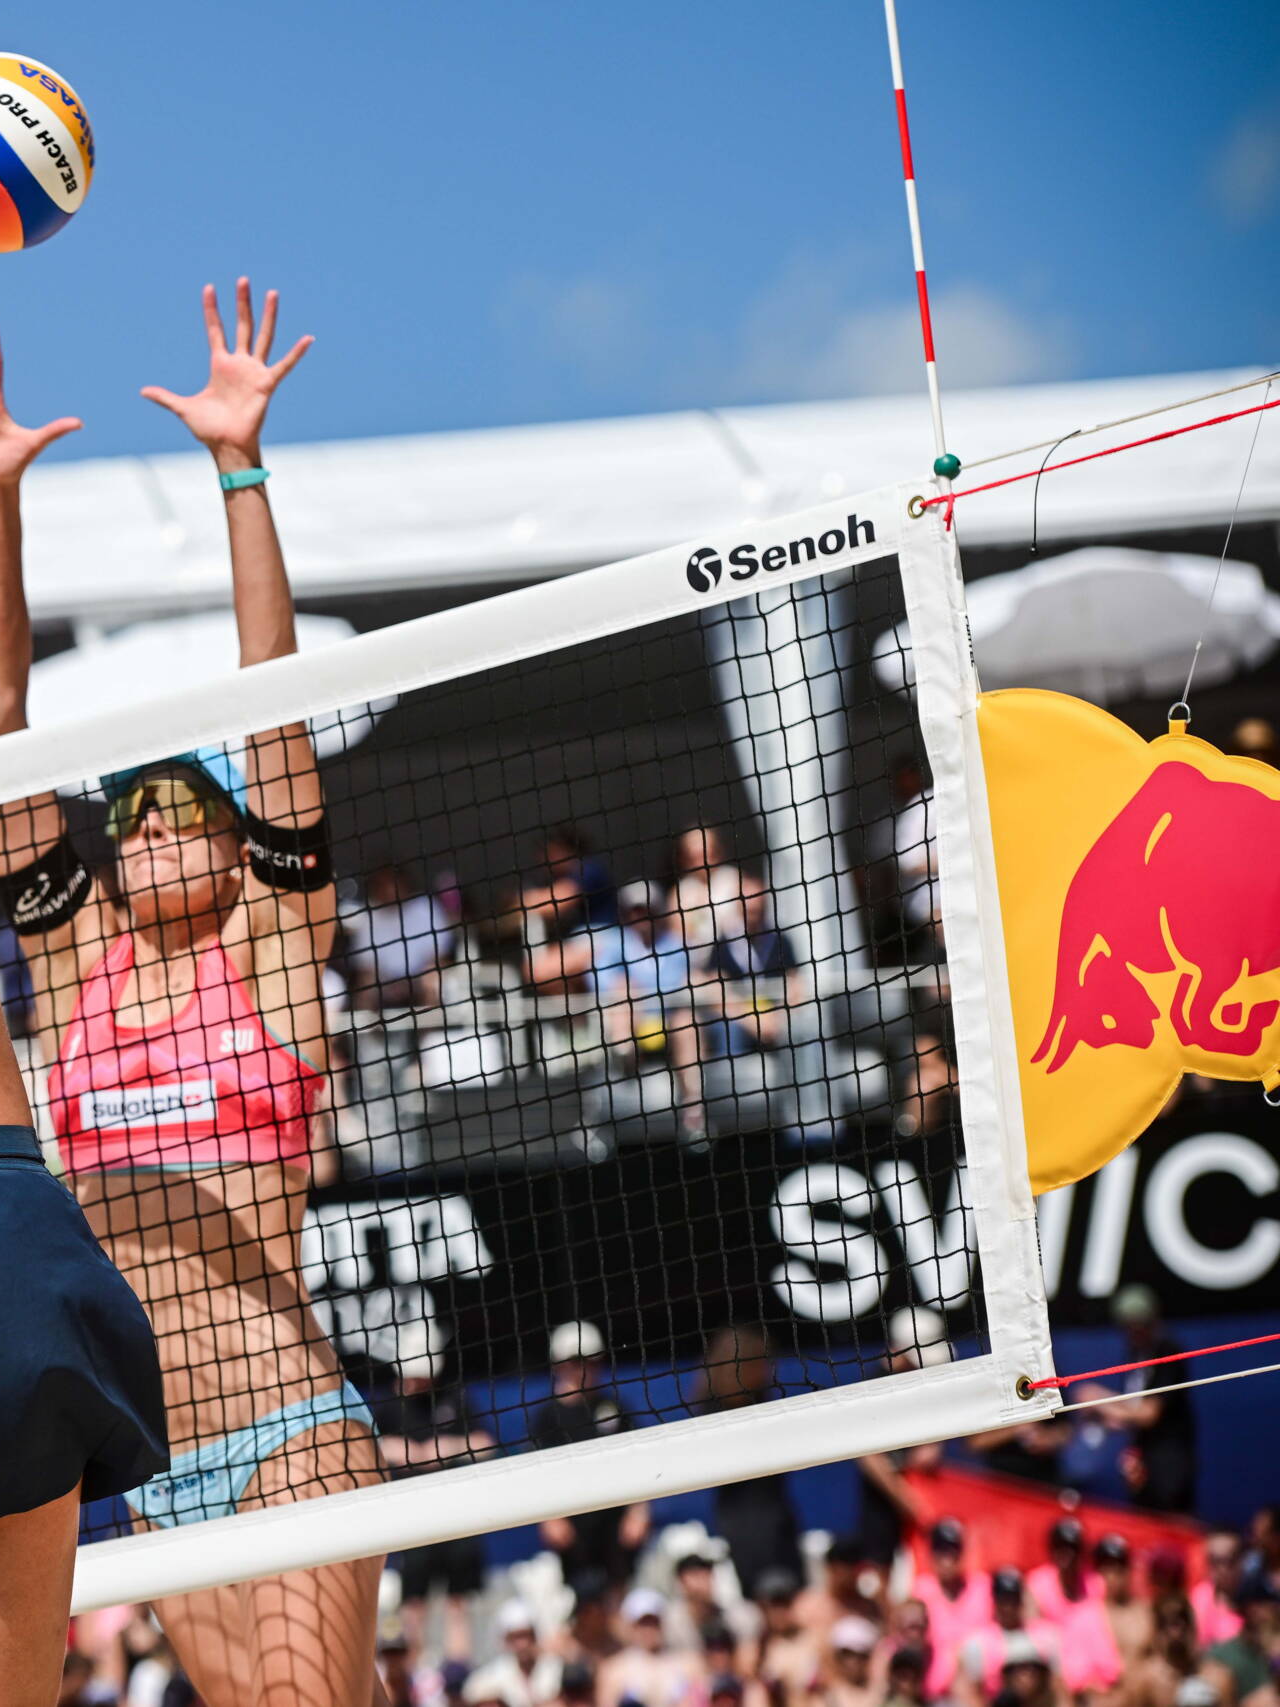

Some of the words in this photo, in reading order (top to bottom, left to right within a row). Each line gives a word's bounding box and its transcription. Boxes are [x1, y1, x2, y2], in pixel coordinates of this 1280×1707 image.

[35, 129, 78, 194] BEACH
[728, 513, 876, 580] Senoh
[219, 1028, 255, 1053] SUI
[91, 1093, 183, 1119] swatch
